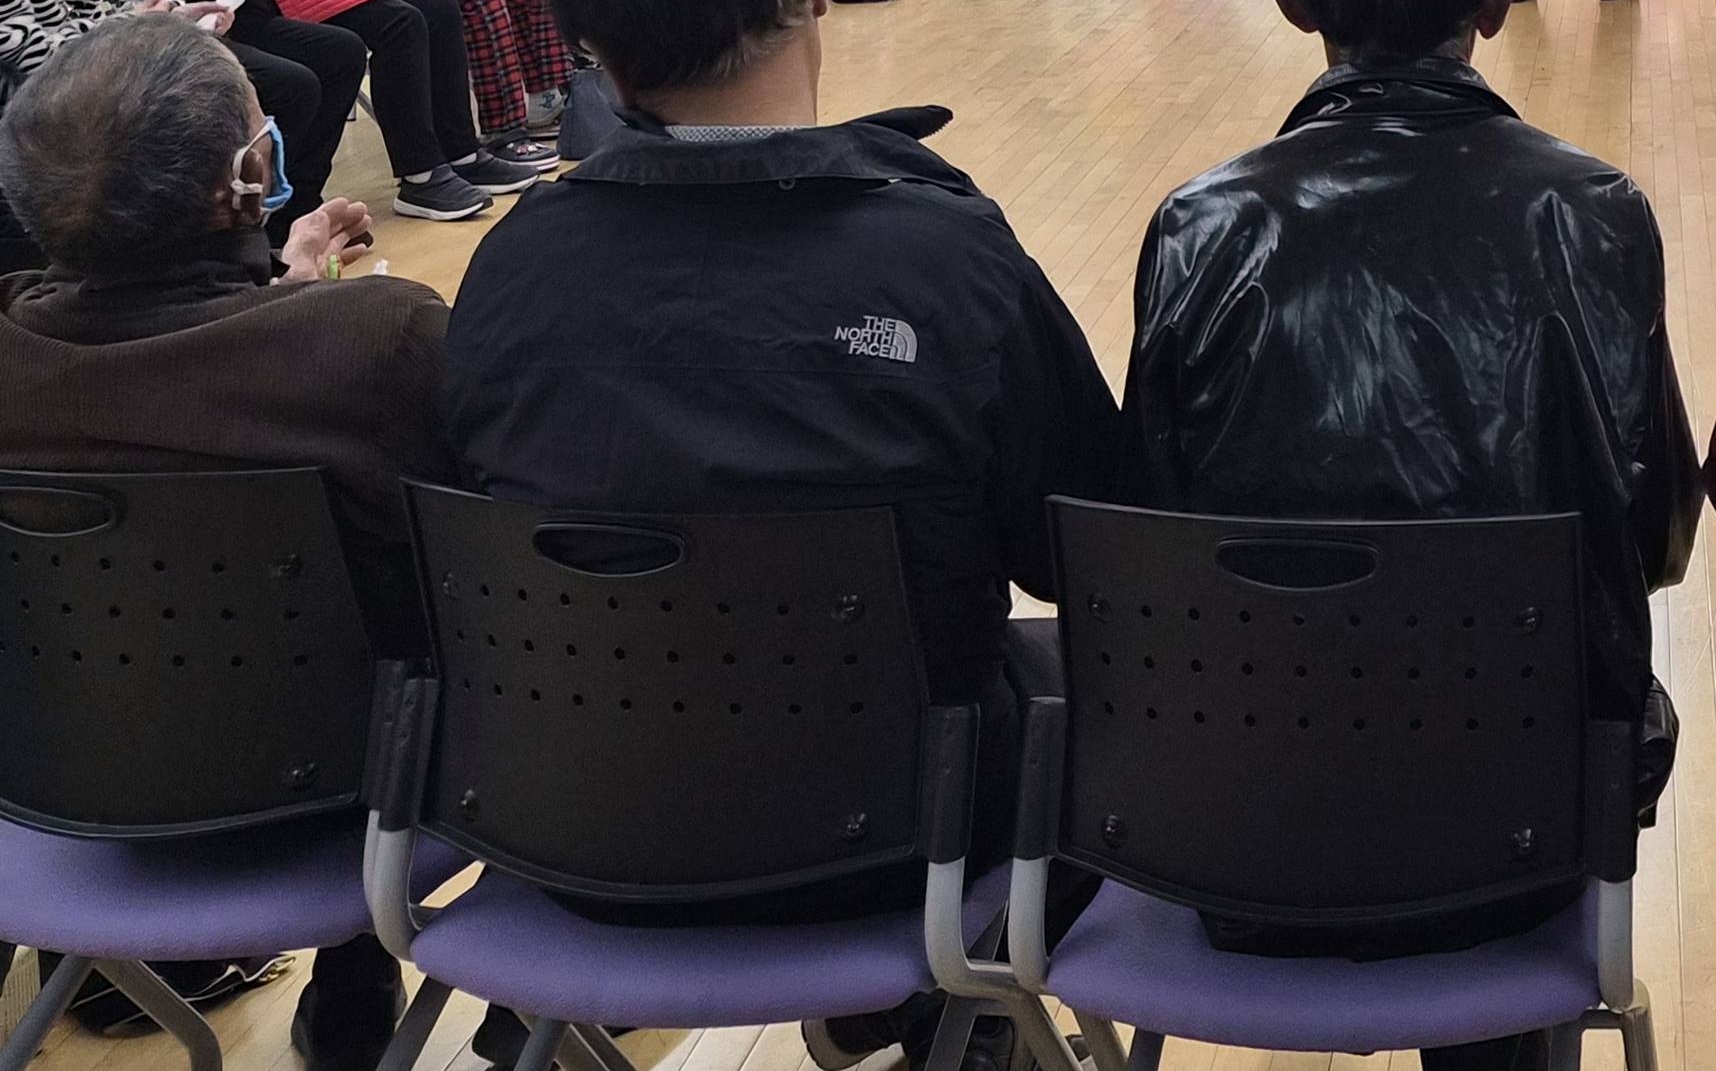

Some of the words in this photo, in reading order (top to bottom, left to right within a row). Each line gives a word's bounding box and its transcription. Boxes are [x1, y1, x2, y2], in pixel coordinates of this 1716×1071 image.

[863, 315, 896, 332] THE
[834, 326, 895, 345] NORTH
[848, 341, 891, 358] FACE
